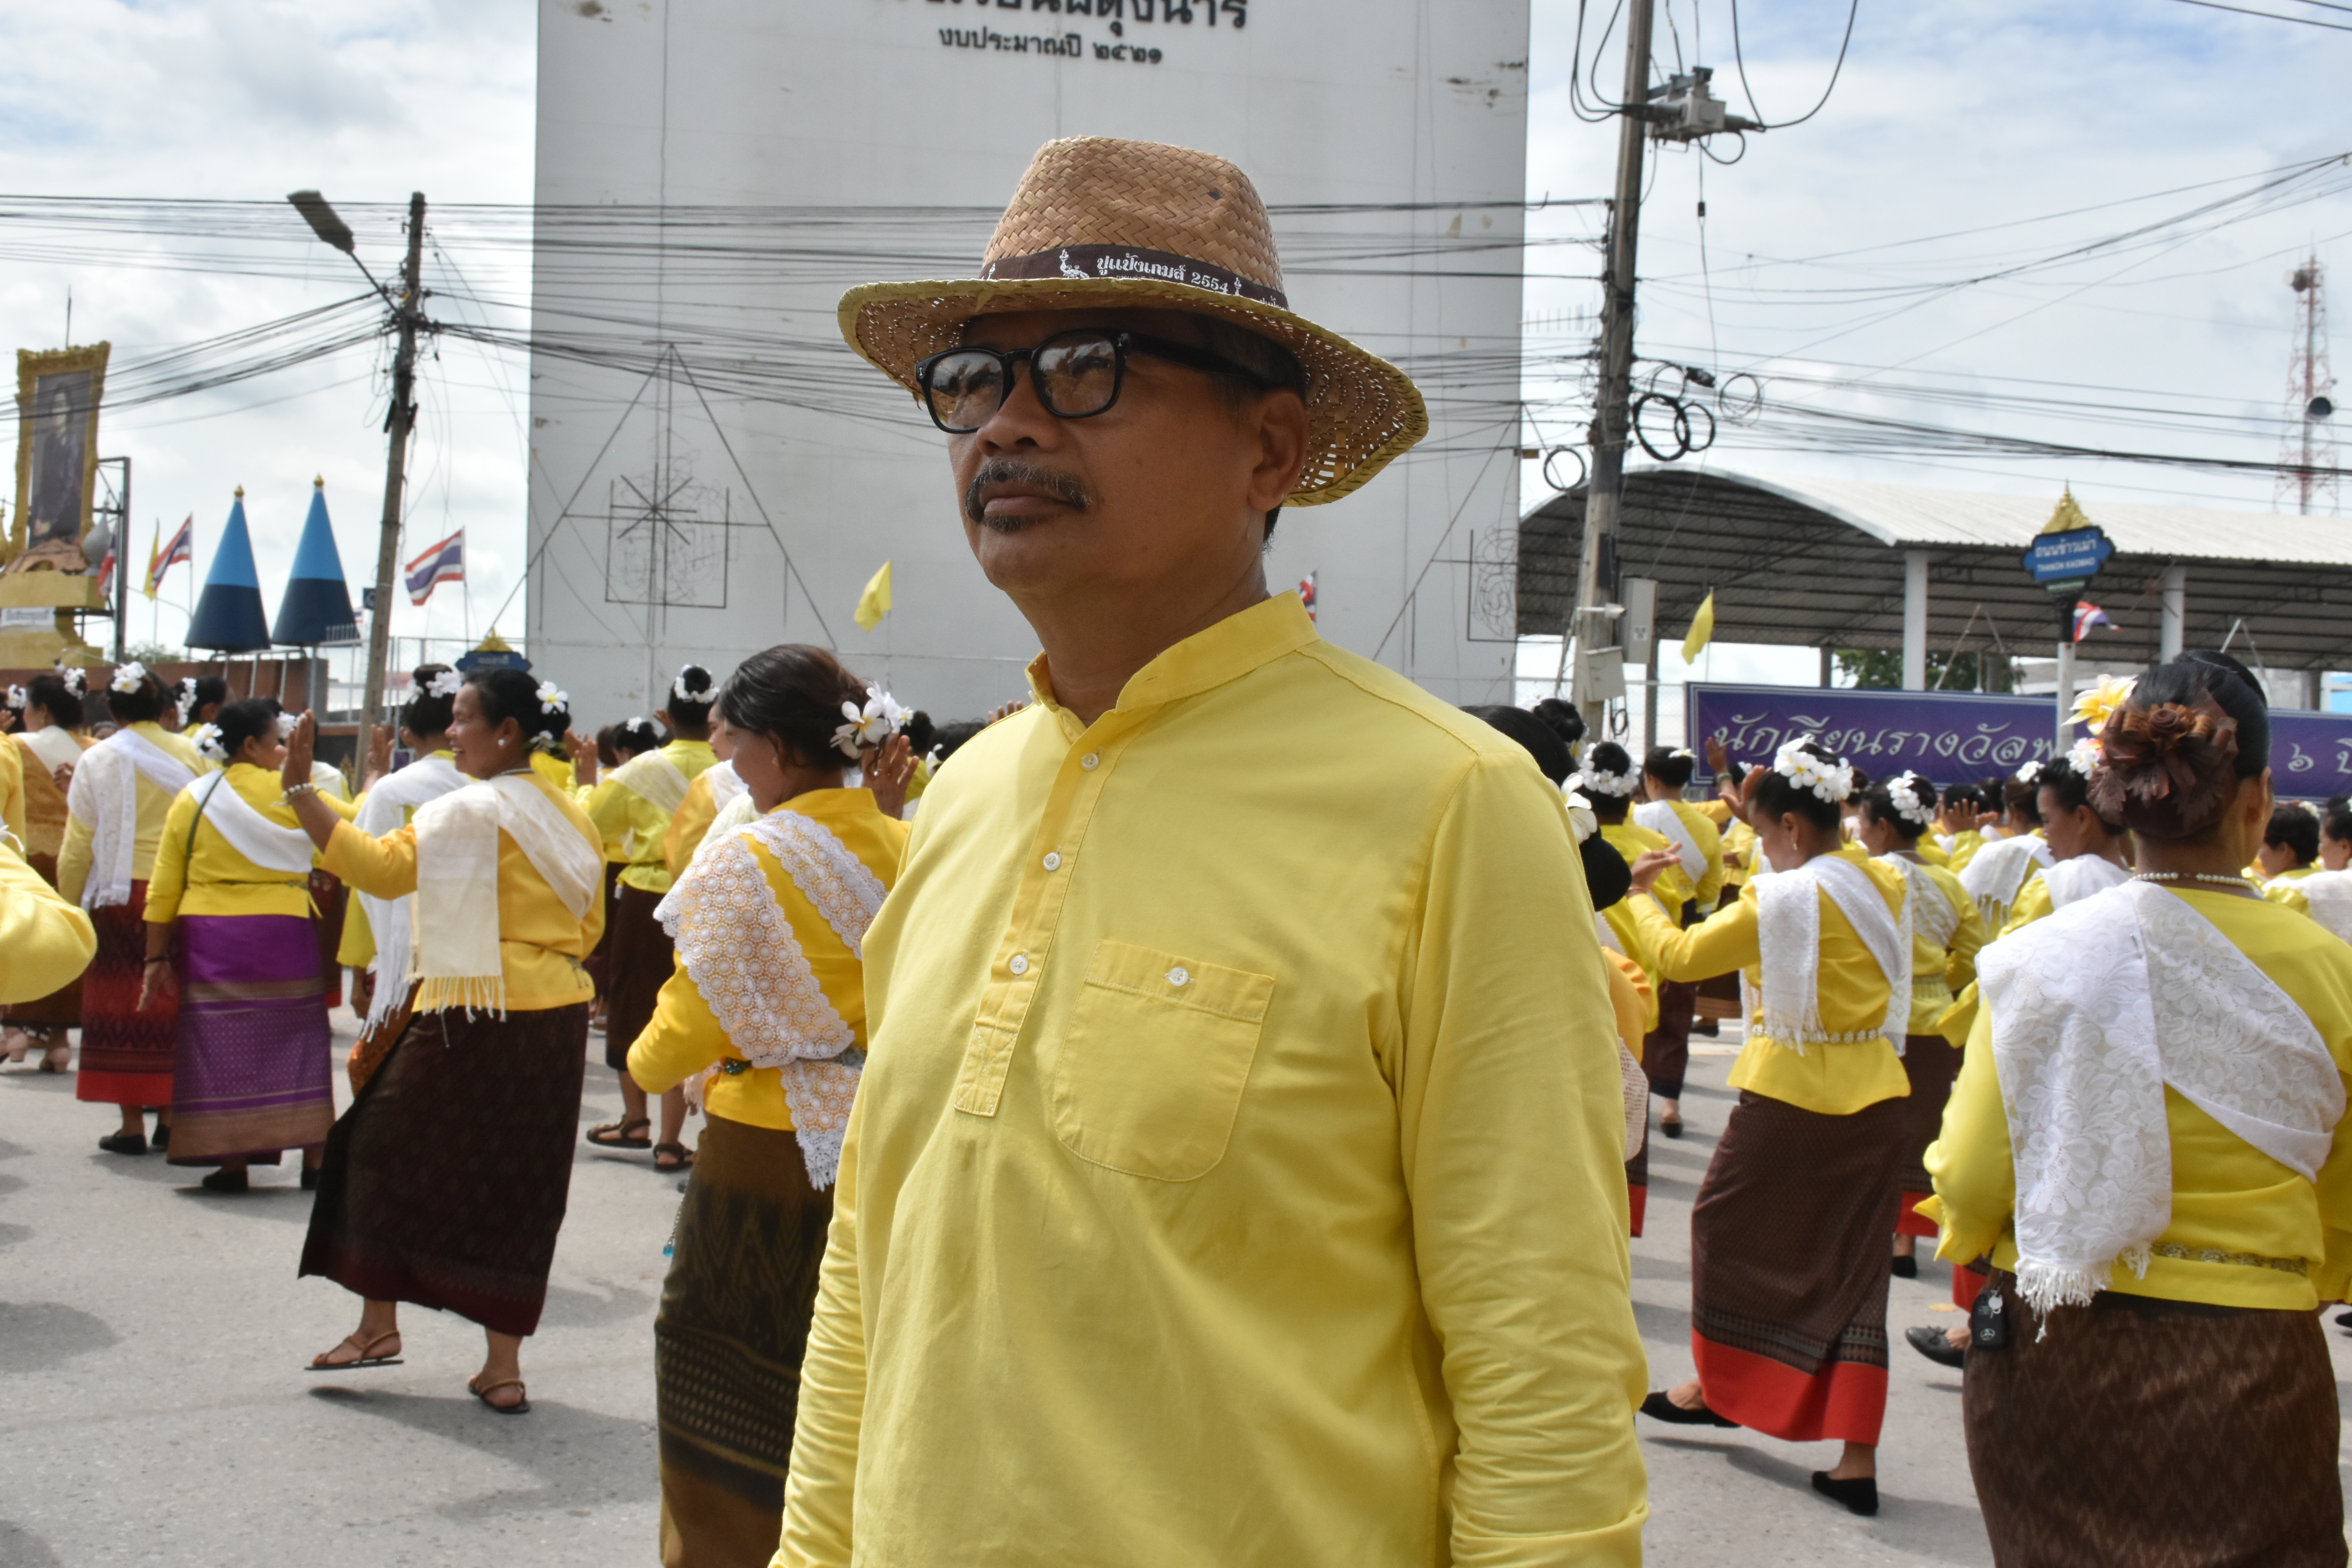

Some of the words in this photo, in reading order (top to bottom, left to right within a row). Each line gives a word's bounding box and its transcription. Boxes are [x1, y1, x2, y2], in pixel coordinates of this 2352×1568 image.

[939, 25, 1082, 58] งบประมาณปี
[1096, 253, 1187, 281] ปูแป้งเกมส์
[1191, 272, 1229, 294] 2554
